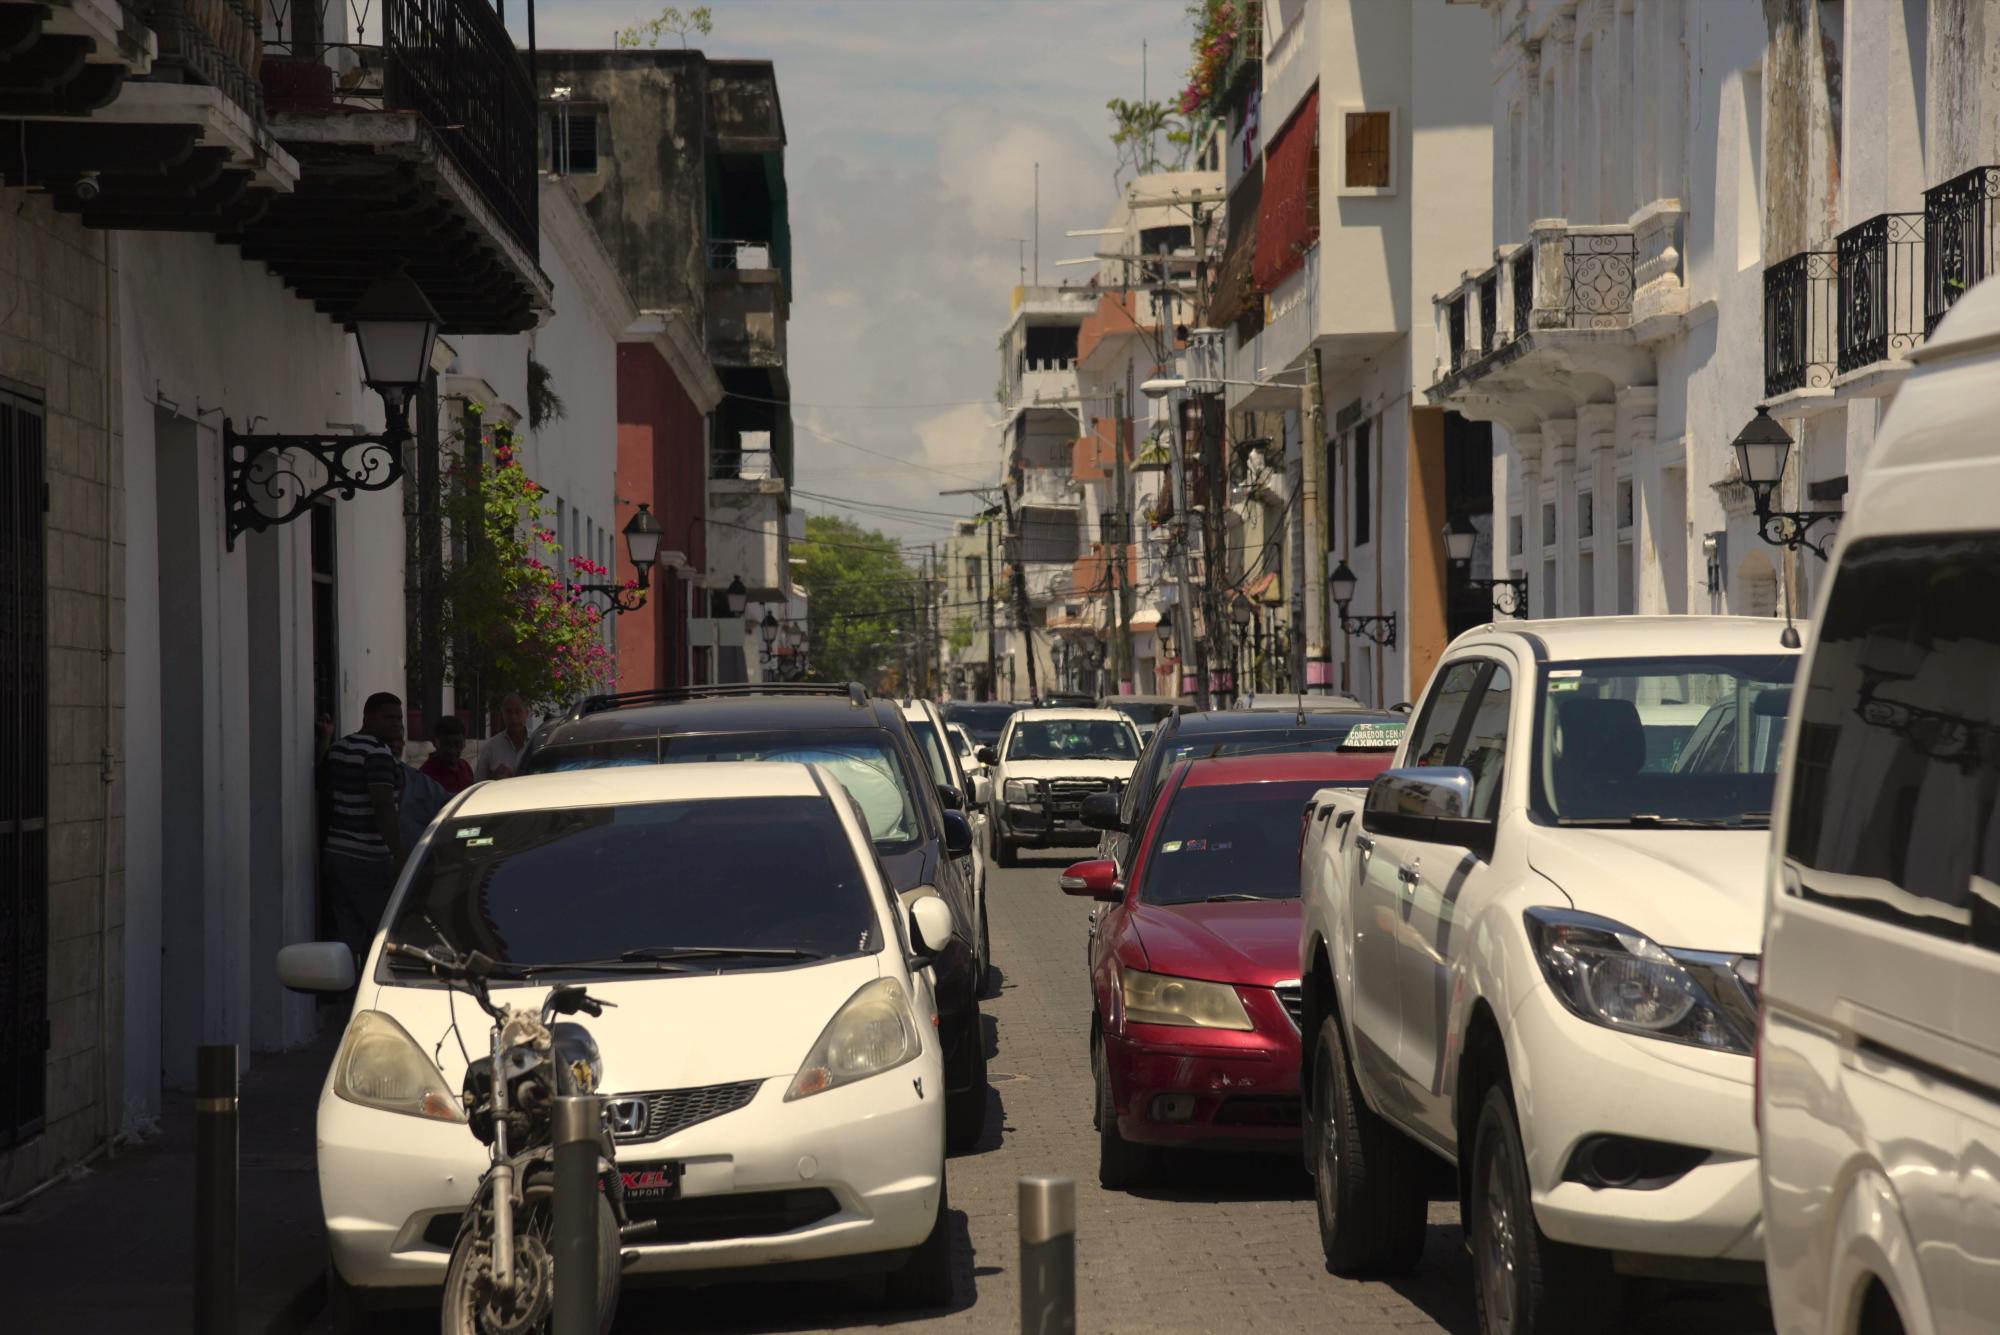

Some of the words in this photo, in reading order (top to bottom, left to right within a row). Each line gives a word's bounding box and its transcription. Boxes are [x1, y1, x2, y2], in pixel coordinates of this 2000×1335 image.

[1350, 729, 1385, 740] CORREDOR
[598, 1171, 673, 1190] XEL
[627, 1188, 666, 1198] IMPORT
